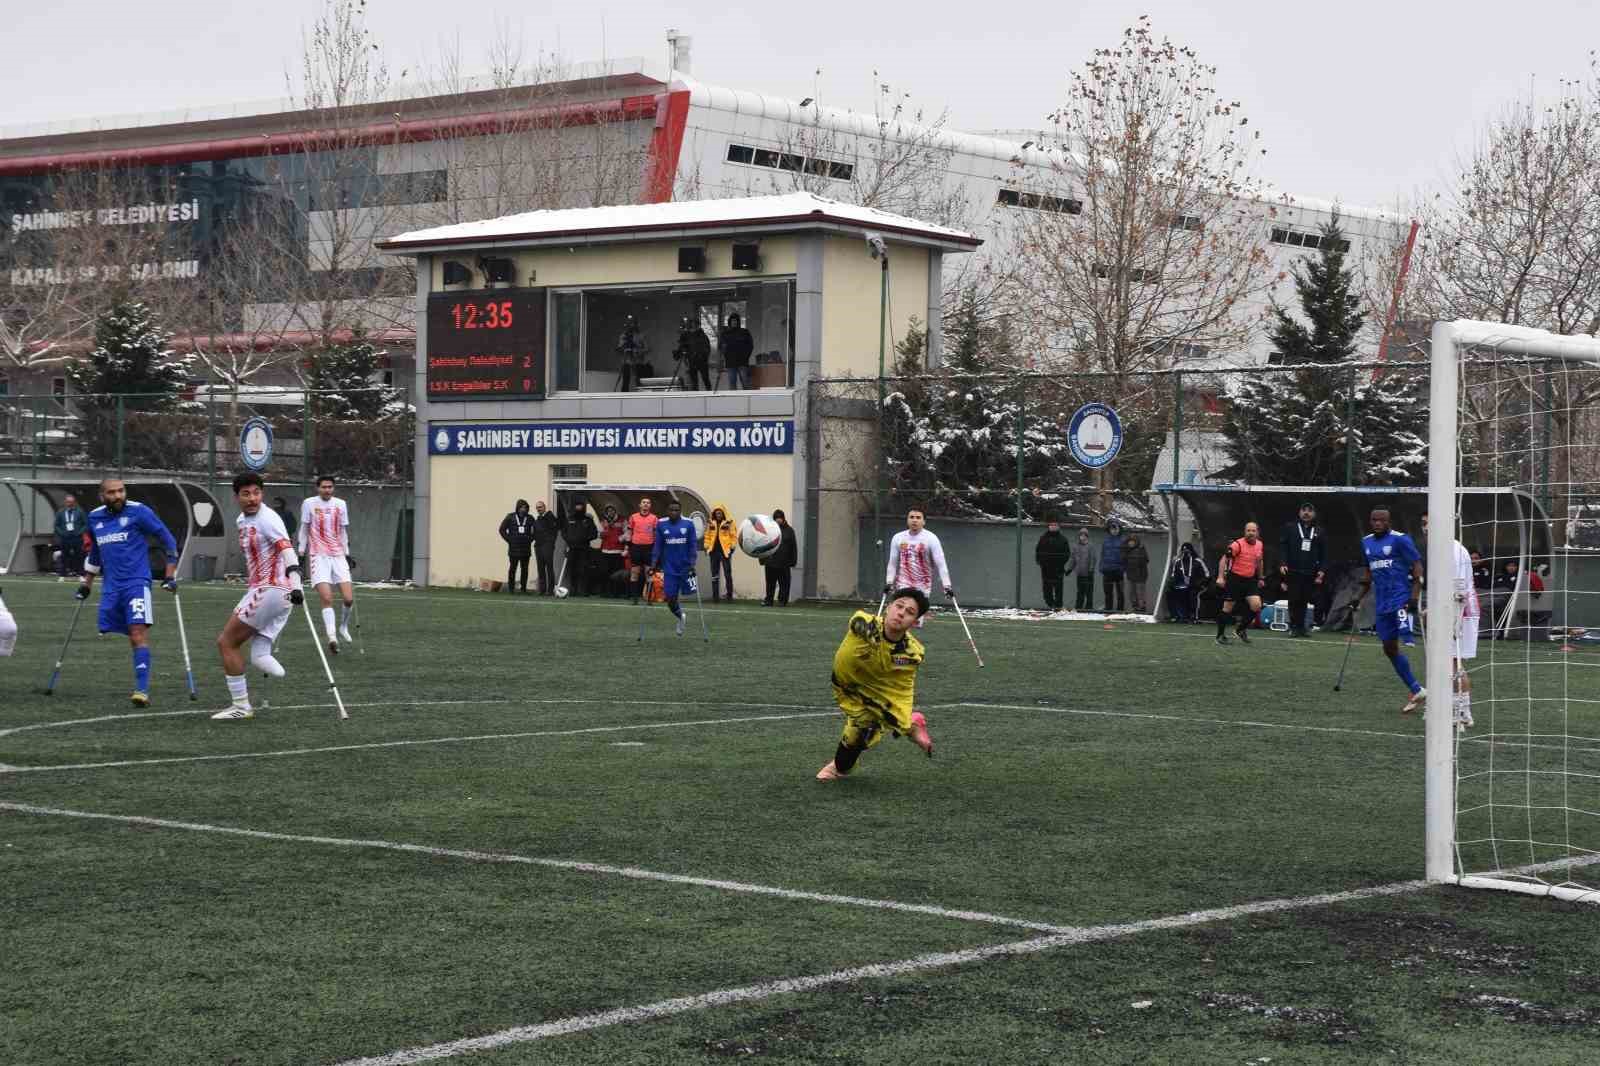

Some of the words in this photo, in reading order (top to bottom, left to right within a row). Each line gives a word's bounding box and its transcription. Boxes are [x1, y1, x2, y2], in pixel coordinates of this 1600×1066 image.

[450, 302, 513, 329] 12:35
[522, 355, 533, 369] 2
[623, 427, 689, 448] AKKENT
[691, 427, 737, 448] SPOR
[739, 422, 786, 448] KÖYÜ
[129, 598, 146, 613] 15
[1397, 608, 1408, 622] 9
